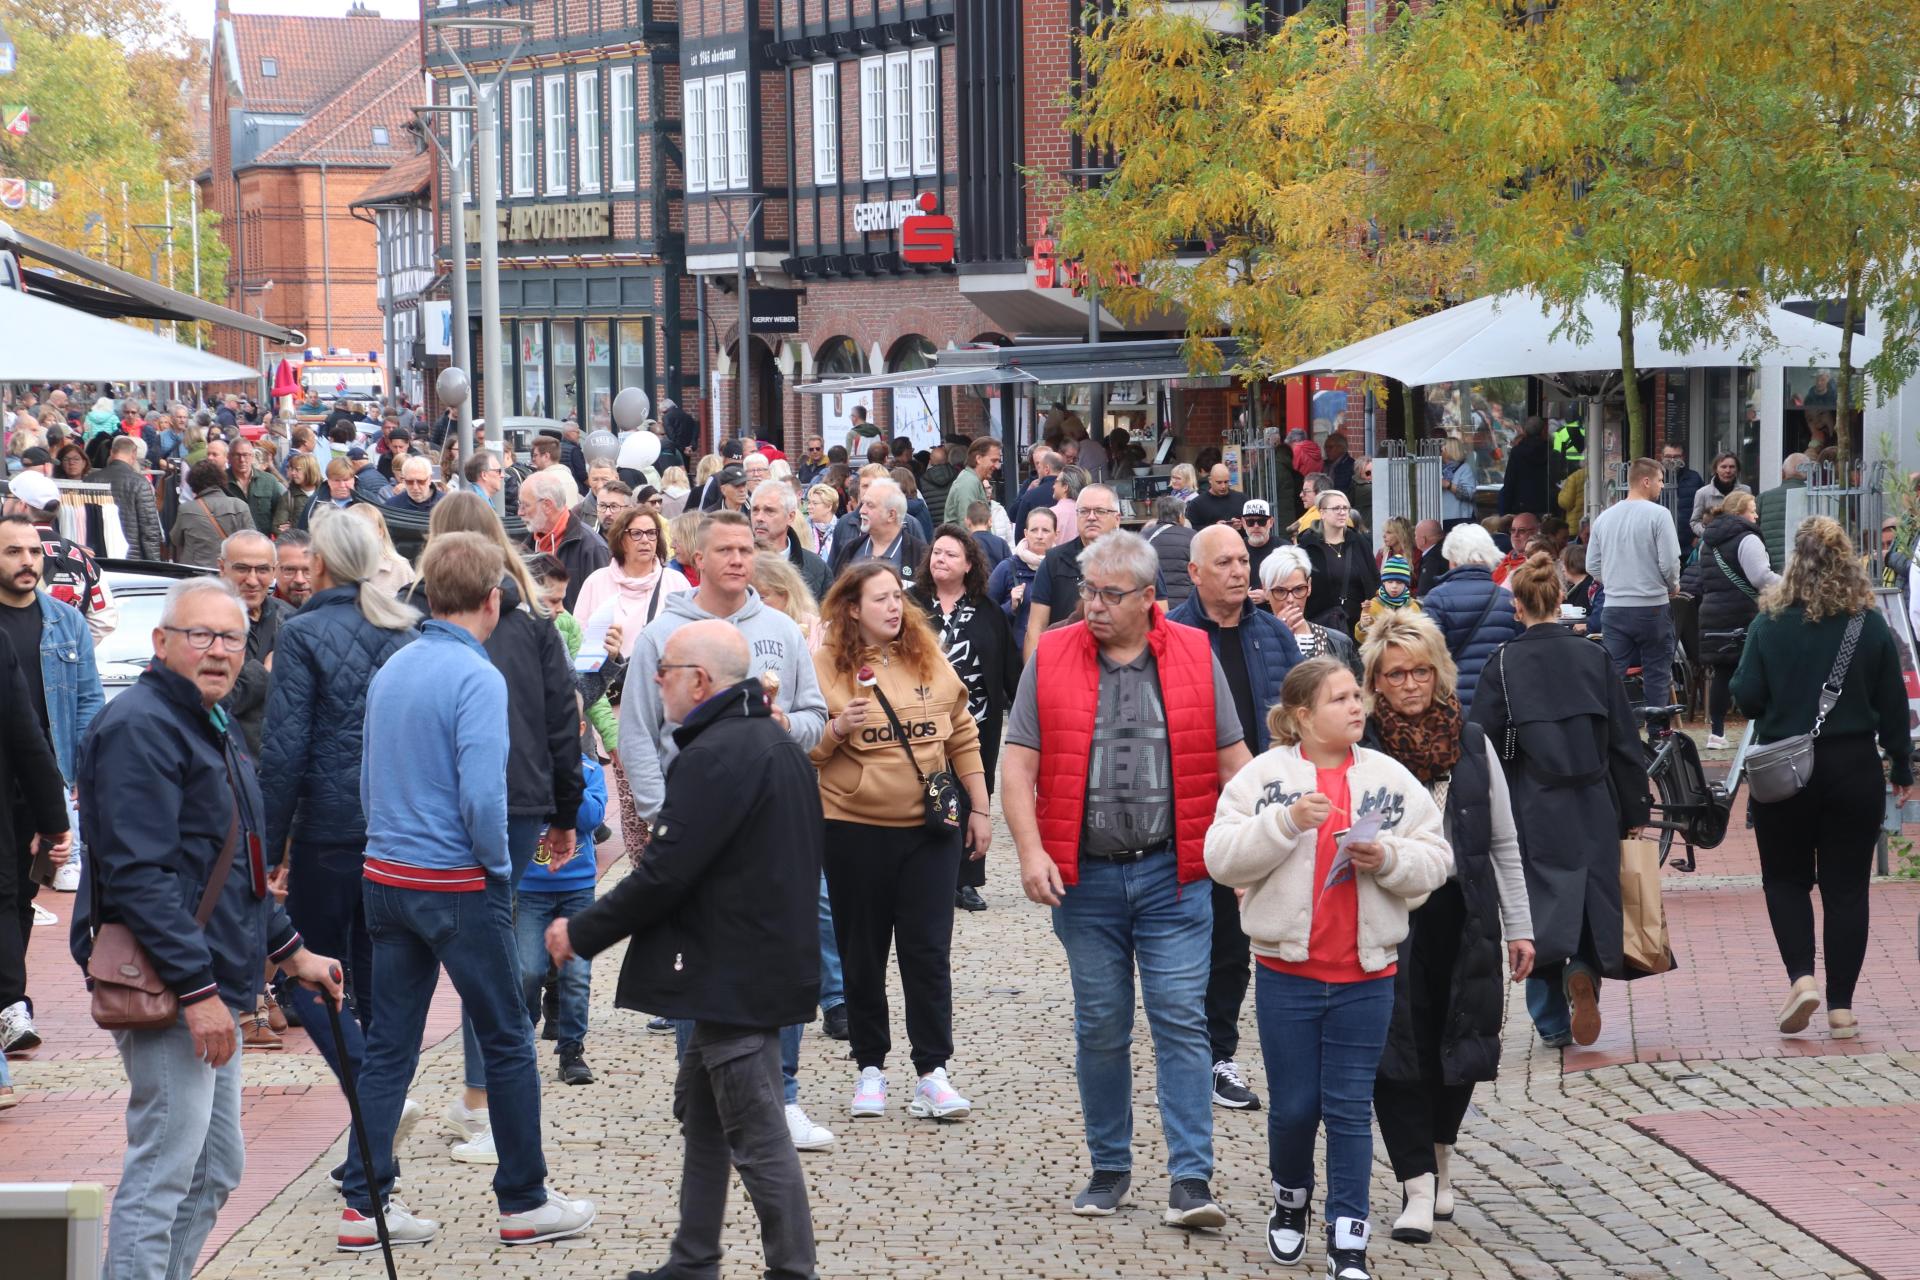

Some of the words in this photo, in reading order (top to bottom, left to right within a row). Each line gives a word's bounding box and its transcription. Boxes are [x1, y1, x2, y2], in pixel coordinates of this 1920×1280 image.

[508, 203, 601, 240] APOTHEKE
[853, 202, 889, 232] GERRY
[754, 639, 784, 659] NIKE
